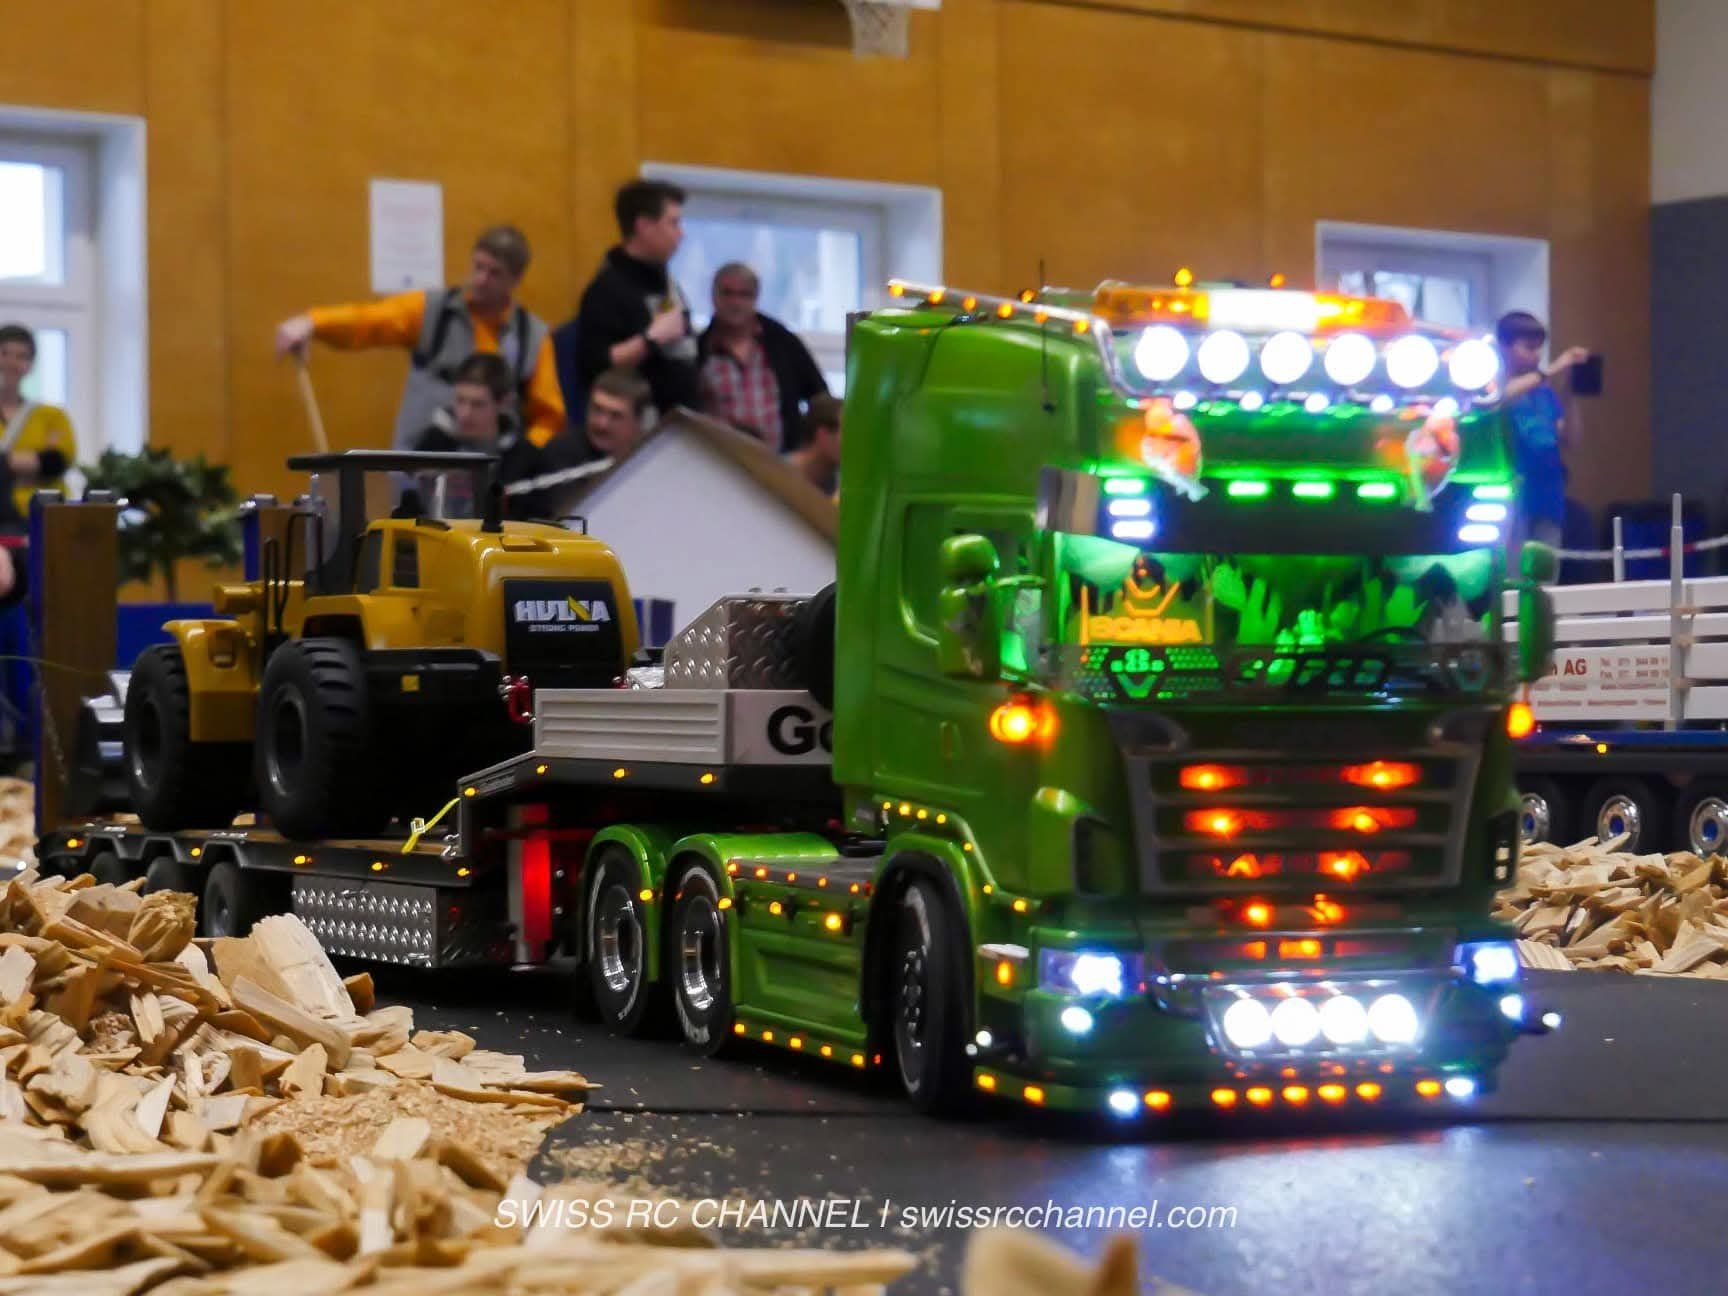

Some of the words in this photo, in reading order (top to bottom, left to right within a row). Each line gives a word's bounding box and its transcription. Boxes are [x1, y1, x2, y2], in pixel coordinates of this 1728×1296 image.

[514, 595, 611, 622] HUINA
[1088, 616, 1204, 644] SCANIA
[1564, 658, 1588, 676] AG
